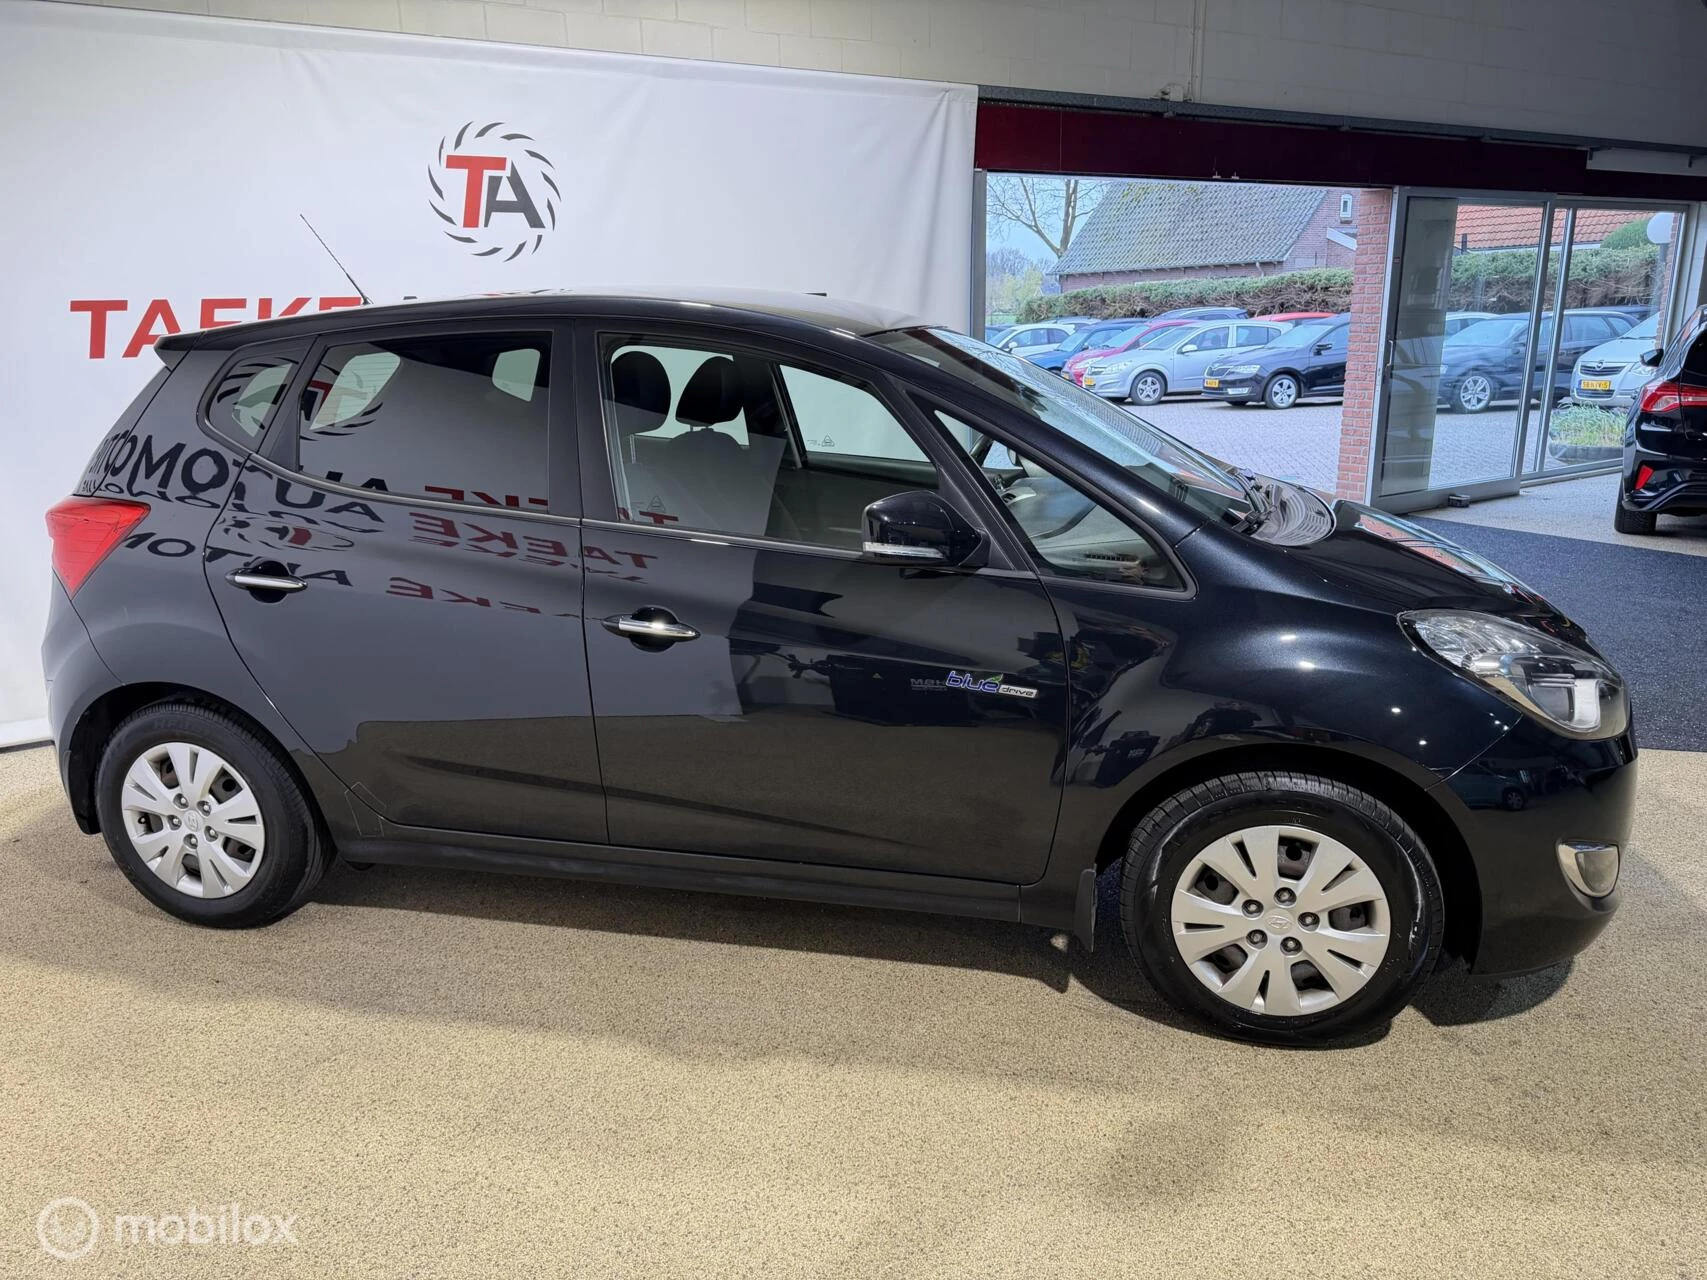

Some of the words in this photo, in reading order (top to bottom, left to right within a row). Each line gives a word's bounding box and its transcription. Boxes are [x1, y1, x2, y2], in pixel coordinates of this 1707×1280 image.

[446, 154, 546, 229] TA
[946, 670, 999, 693] blue
[1001, 686, 1035, 697] drive
